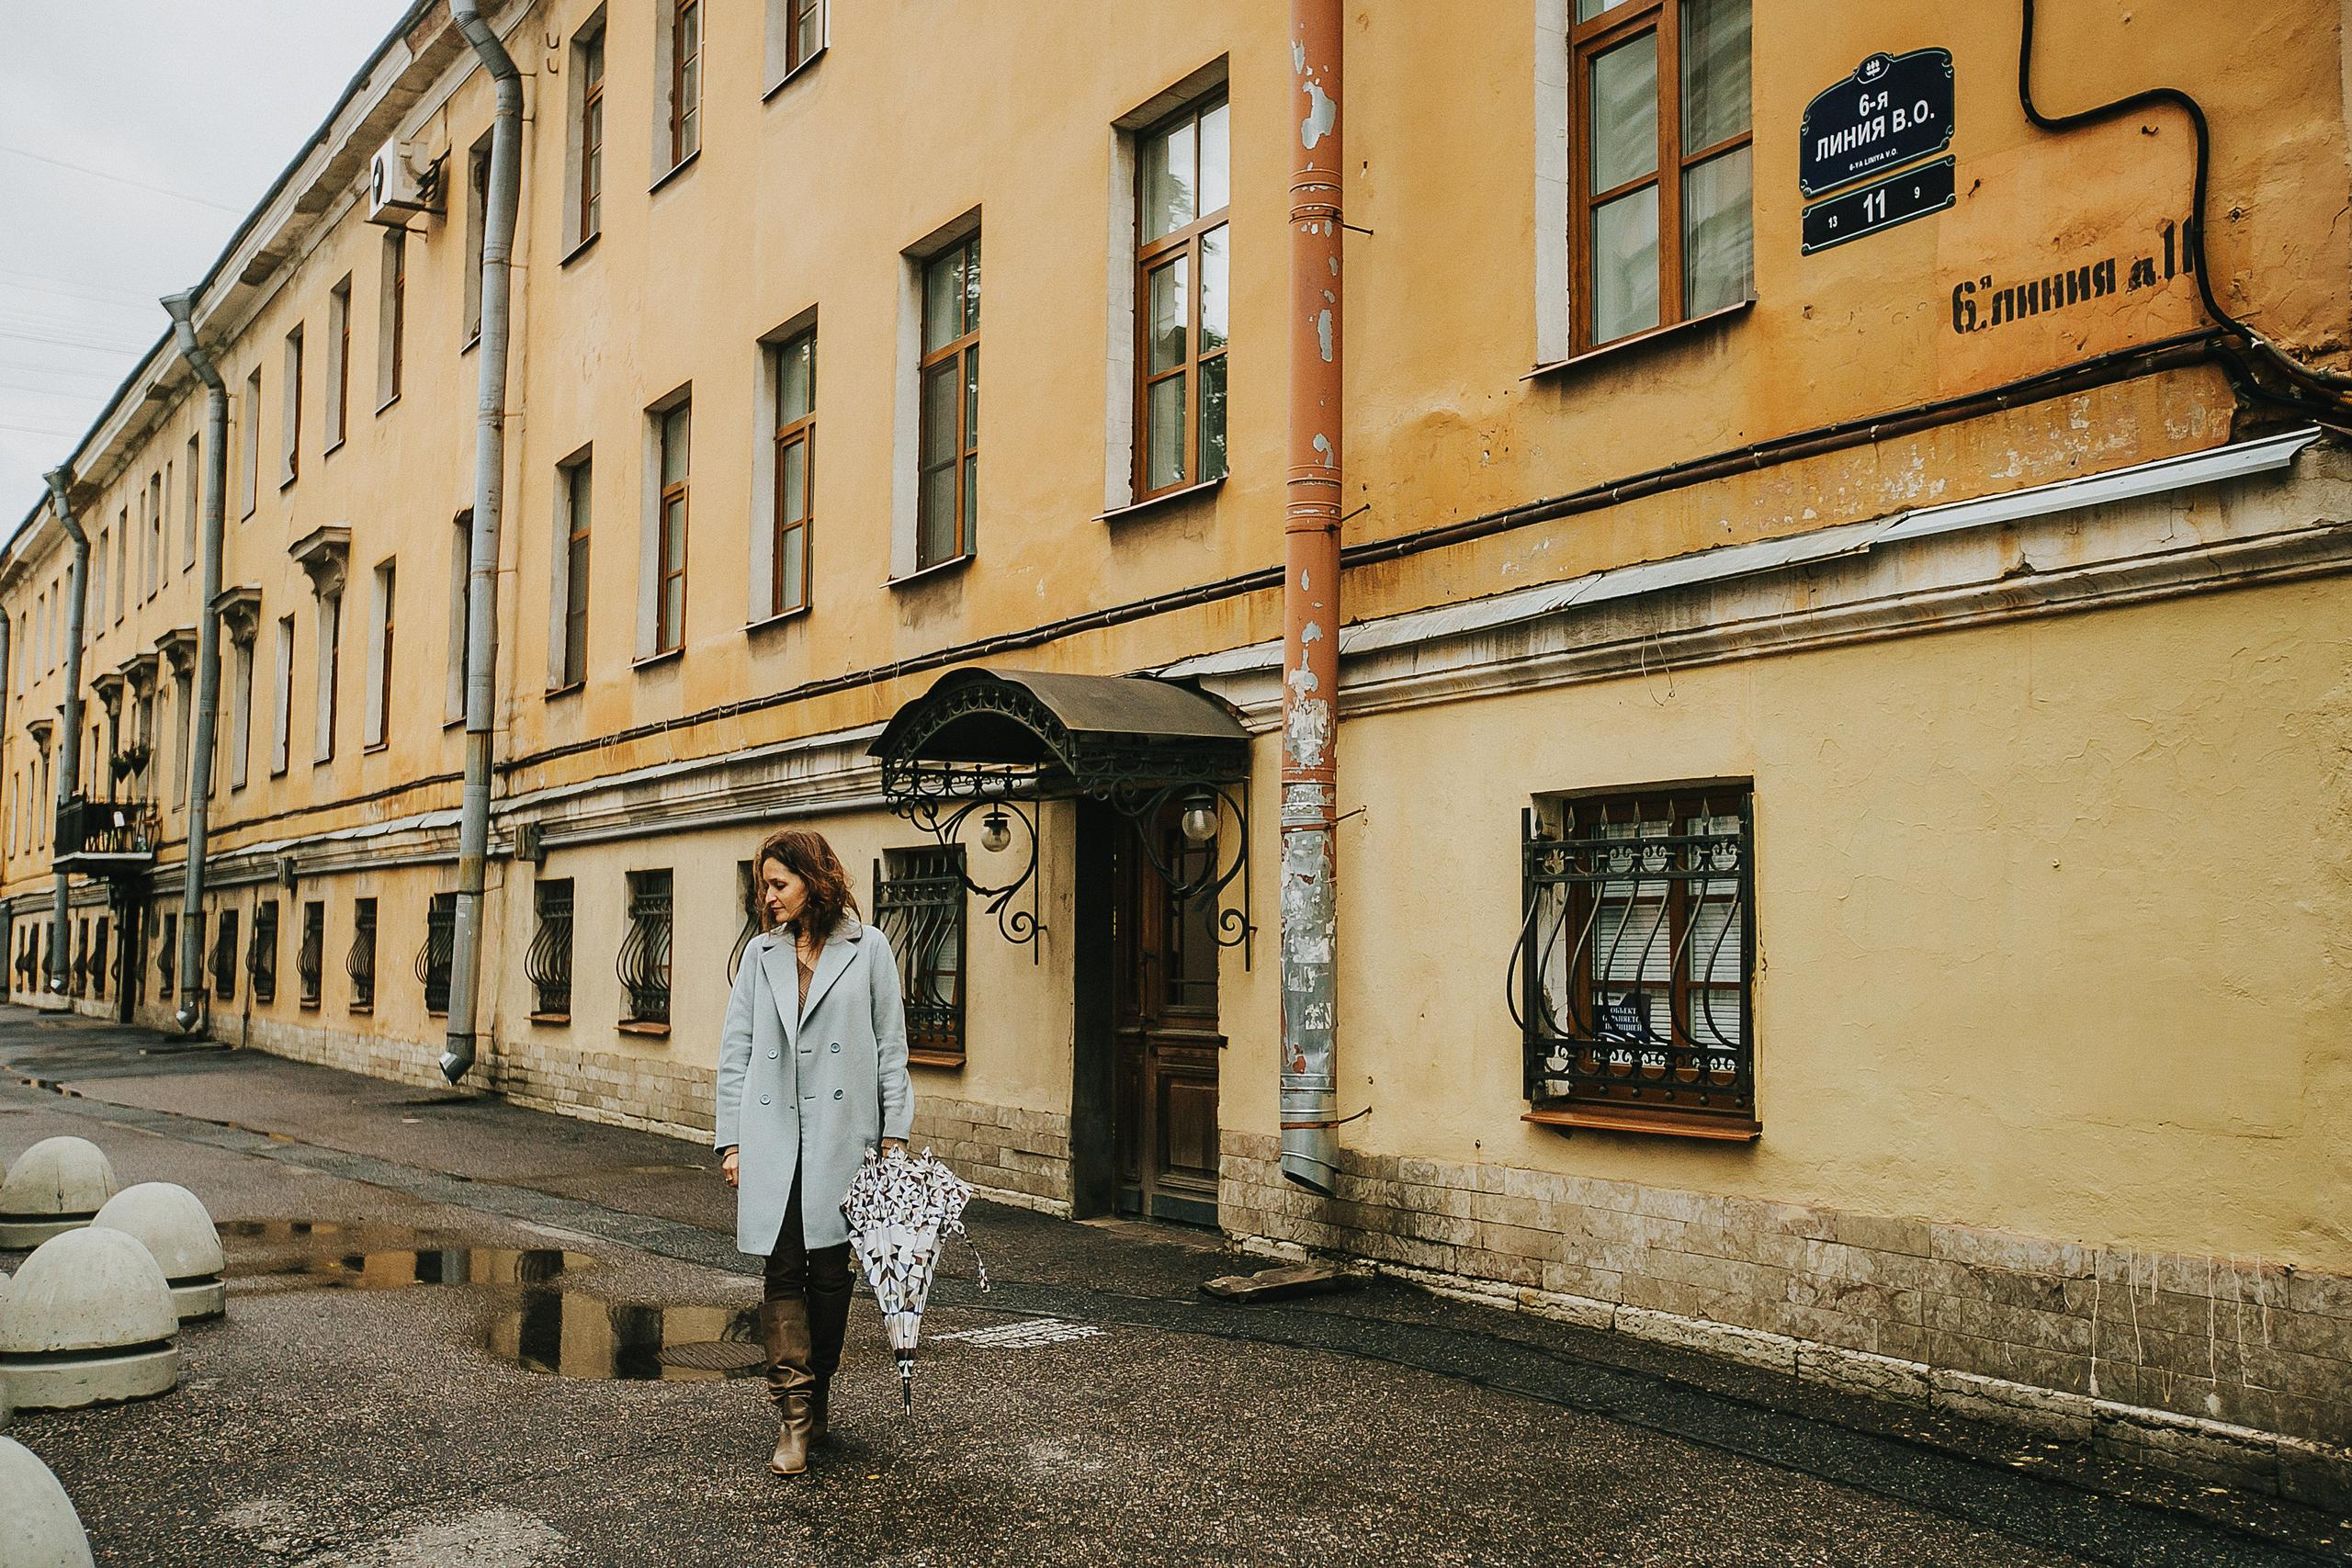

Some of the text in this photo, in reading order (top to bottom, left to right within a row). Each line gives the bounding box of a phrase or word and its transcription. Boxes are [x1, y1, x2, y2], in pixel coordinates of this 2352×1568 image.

[1815, 100, 1935, 163] ЛИНИЯ В.О.
[1849, 161, 1863, 171] 6-YA
[1864, 152, 1884, 166] LINIYA
[1828, 186, 1921, 229] 13 11 9
